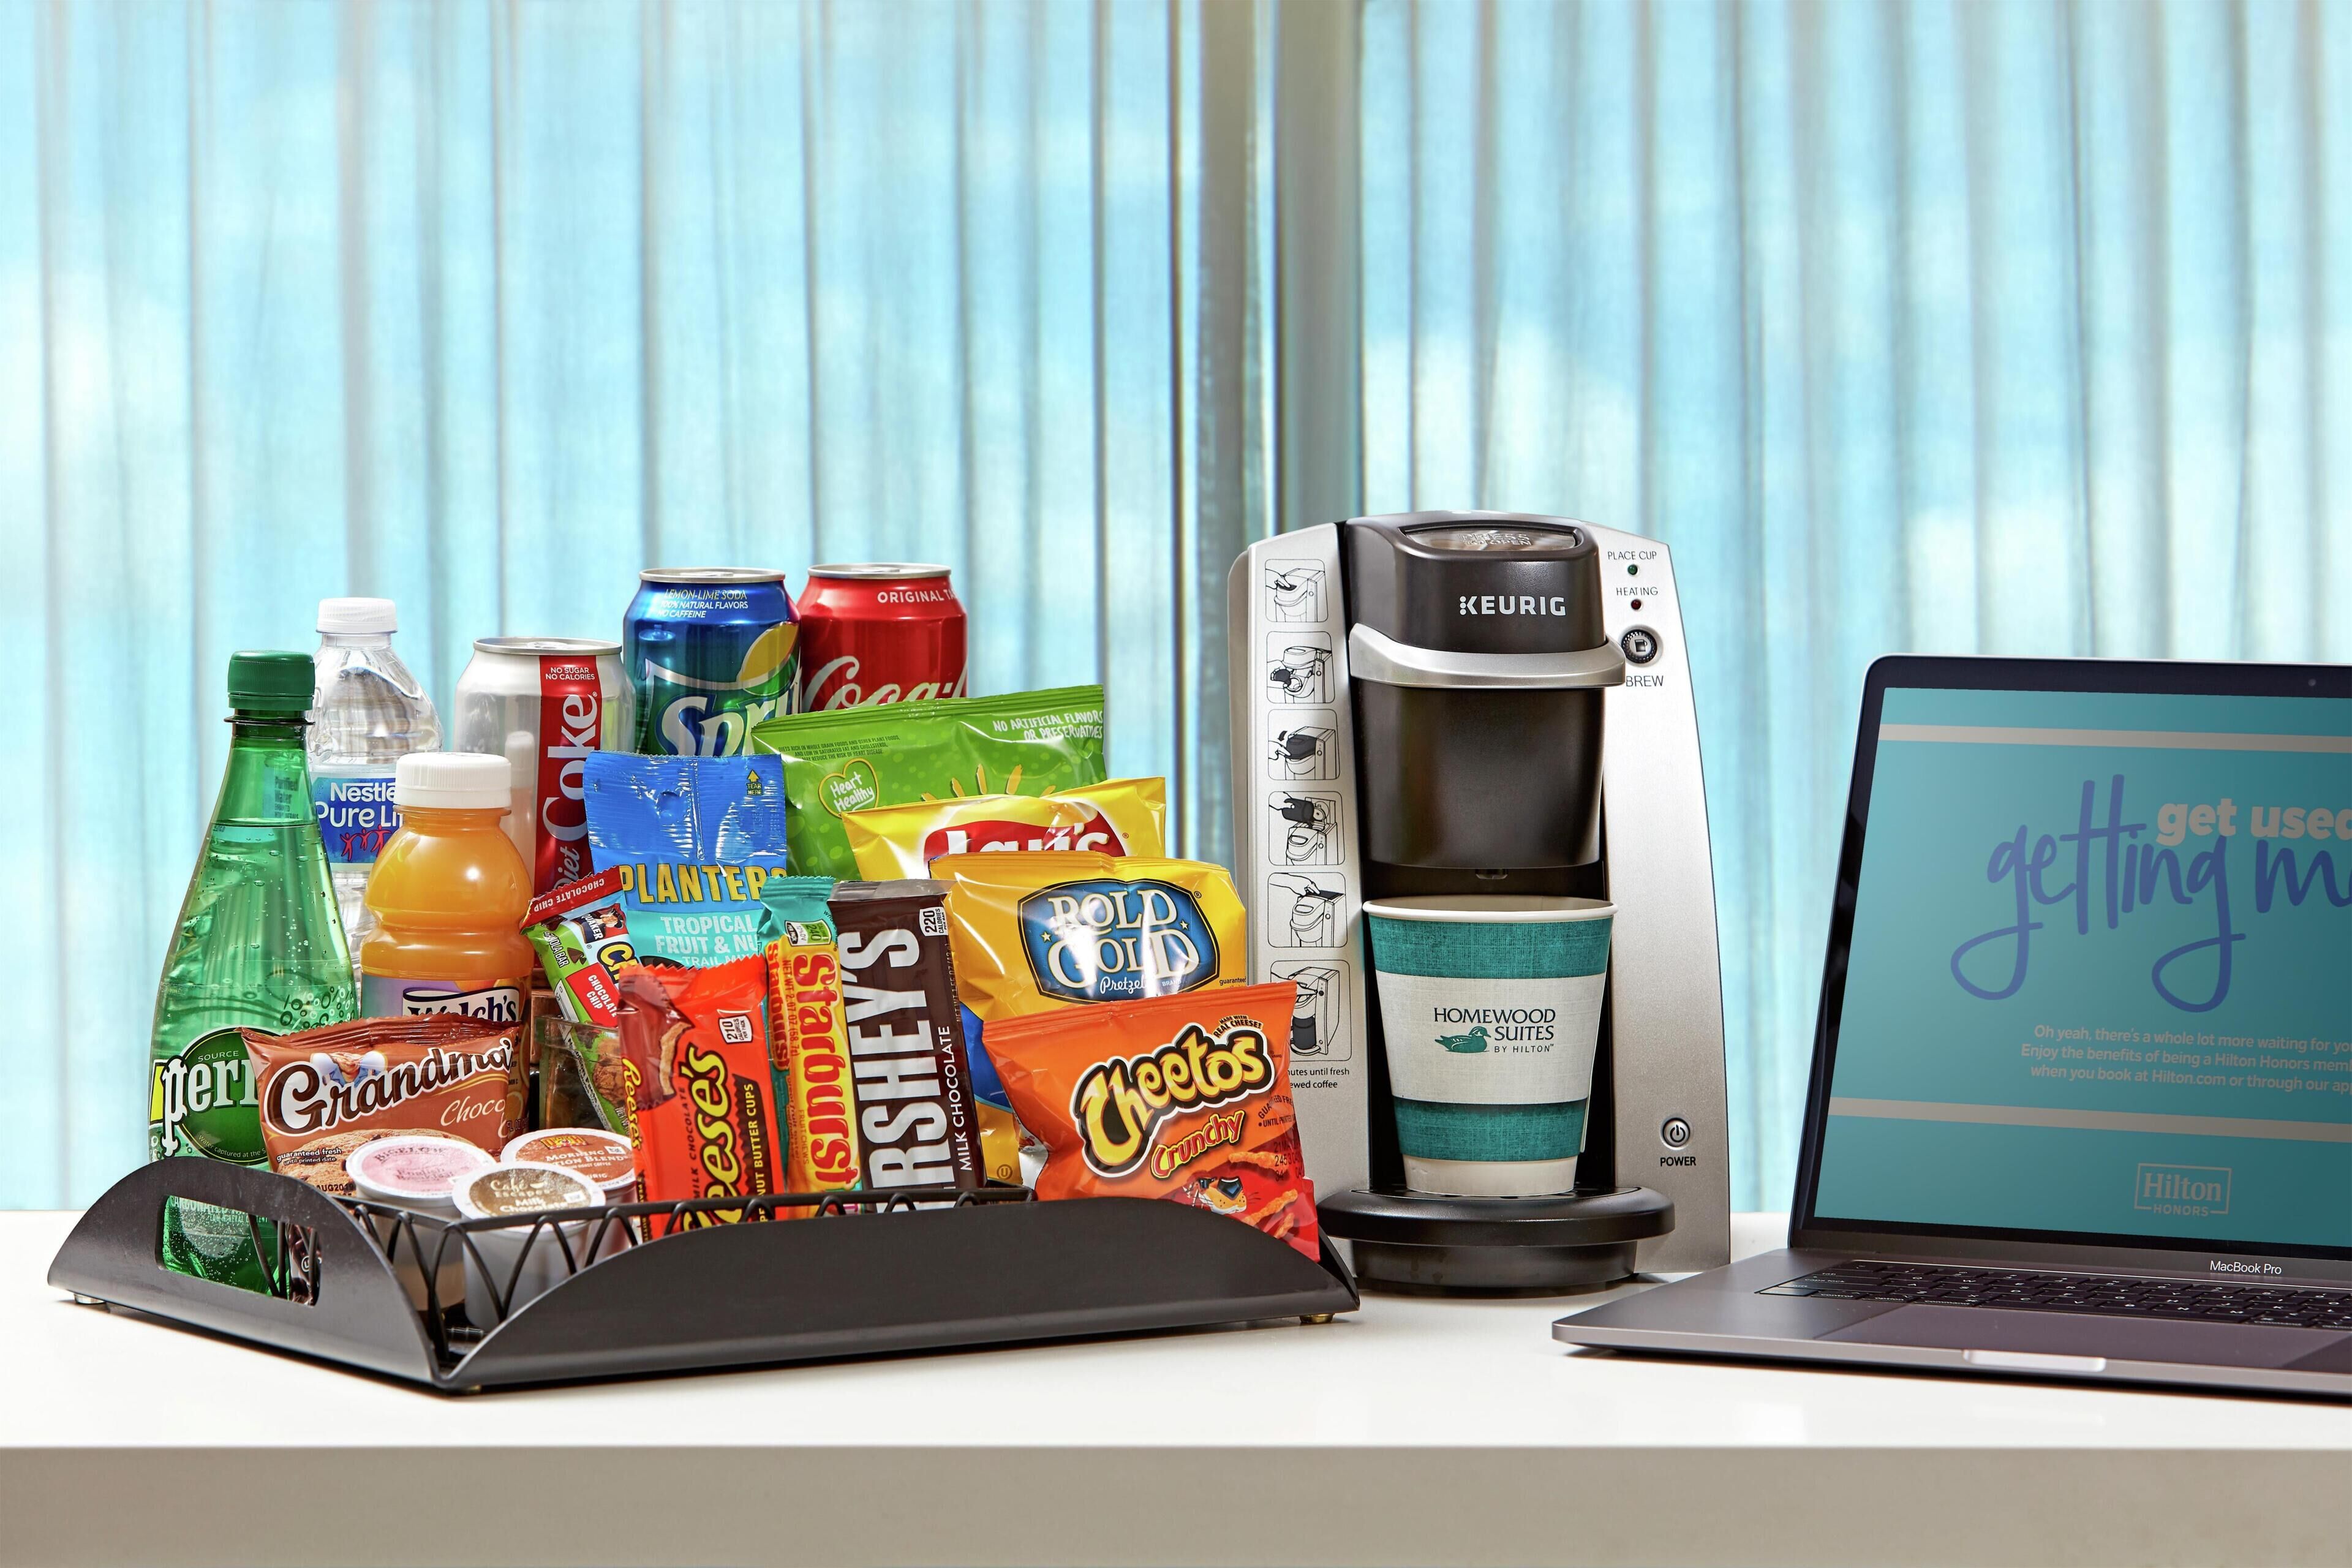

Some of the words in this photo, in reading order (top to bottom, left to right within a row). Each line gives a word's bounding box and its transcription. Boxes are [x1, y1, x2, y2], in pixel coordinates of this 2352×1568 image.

[1607, 551, 1636, 560] PLACE
[1638, 551, 1657, 560] CUP
[663, 589, 719, 600] LEMON-LIME
[722, 589, 747, 600] SODA
[876, 590, 944, 603] ORIGINAL
[1616, 587, 1658, 596] HEATING
[1459, 596, 1566, 616] KEURIG
[802, 655, 968, 714] Coca-
[1626, 675, 1664, 688] BREW
[992, 720, 1008, 732] NO
[1011, 714, 1063, 730] ARTIFICIAL
[1064, 710, 1103, 724] FLAVORS
[1023, 729, 1038, 741] OR
[1039, 724, 1103, 741] PRESERVATIVES
[543, 694, 598, 842] Coke
[830, 771, 862, 797] Heart
[834, 786, 875, 813] Healthy
[315, 801, 375, 828] Pure
[2155, 798, 2237, 846] get
[556, 877, 605, 903] CHOCOLATE
[1950, 773, 2246, 1013] getting
[533, 900, 554, 913] CHIP
[1047, 889, 1178, 935] ROLD
[581, 913, 603, 940] QUAKER
[660, 914, 757, 934] TROPICAL
[923, 910, 938, 933] 220
[935, 908, 944, 934] CALORIES
[805, 924, 821, 941] 240
[655, 935, 709, 954] FRUIT
[714, 934, 731, 953] &
[556, 949, 570, 968] BAR
[682, 954, 722, 967] TRAIL
[782, 959, 791, 974] NET
[1047, 929, 1200, 989] GOLD
[588, 974, 617, 1018] CHOCOLATE
[784, 979, 794, 994] WT
[1099, 977, 1147, 994] Pretzel
[586, 991, 603, 1009] CHIP
[767, 942, 790, 1068] Starburst
[1219, 1016, 1233, 1025] MADE
[1434, 1007, 1556, 1023] HOMEWOOD
[722, 1021, 737, 1040] 210
[734, 1018, 745, 1041] CALORIES
[1213, 1023, 1231, 1038] REAL
[1230, 1019, 1262, 1029] CHEESE!
[1494, 1025, 1554, 1041] SUITES
[2034, 1024, 2054, 1038] Oh
[2057, 1027, 2092, 1041] yeah,
[2095, 1027, 2139, 1041] there's
[2142, 1033, 2150, 1043] a
[2154, 1030, 2194, 1045] whole
[2196, 1032, 2215, 1046] lot
[2218, 1036, 2254, 1048] more
[2257, 1036, 2308, 1054] waiting
[2310, 1038, 2330, 1051] for
[198, 1050, 239, 1063] SOURCE
[2021, 1042, 2059, 1060] Enjoy
[2062, 1046, 2084, 1059] the
[2087, 1047, 2142, 1062] benefits
[2145, 1050, 2160, 1063] of
[2162, 1051, 2200, 1068] being
[2203, 1054, 2212, 1065] a
[2214, 1052, 2256, 1068] Hilton
[2260, 1055, 2310, 1070] Honors
[793, 954, 858, 1184] Starburst
[837, 929, 956, 1213] RSHEY'S
[938, 1025, 965, 1128] CHOCOLATE
[1330, 1067, 1350, 1076] fresh
[2030, 1064, 2067, 1078] when
[2069, 1068, 2094, 1082] you
[2097, 1067, 2132, 1081] book
[2135, 1069, 2149, 1082] at
[2151, 1069, 2226, 1085] Hilton.com
[2229, 1075, 2244, 1087] or
[2247, 1074, 2302, 1092] through
[2305, 1080, 2330, 1091] our
[1313, 1080, 1338, 1088] coffee
[621, 1057, 642, 1150] Reese's
[744, 1083, 757, 1115] CUPS
[1080, 1031, 1265, 1166] Cheetos
[678, 1087, 697, 1160] CHOCOLATE
[1263, 1117, 1279, 1127] UNTIL
[198, 1134, 214, 1149] Water
[214, 1146, 241, 1158] captured
[748, 1120, 764, 1168] BUTTER
[801, 1136, 810, 1164] CHEWS
[954, 1131, 973, 1171] MILK
[1150, 1110, 1245, 1178] Crunchy
[276, 1148, 320, 1163] guaranteed
[284, 1157, 298, 1166] until
[1660, 1156, 1697, 1167] POWER
[490, 1178, 529, 1193] Café
[691, 1167, 700, 1199] MILK
[2143, 1172, 2222, 1202] Hilton
[2153, 1204, 2210, 1217] HONORS
[2209, 1259, 2261, 1274] MacBook
[2263, 1263, 2282, 1275] Pro
